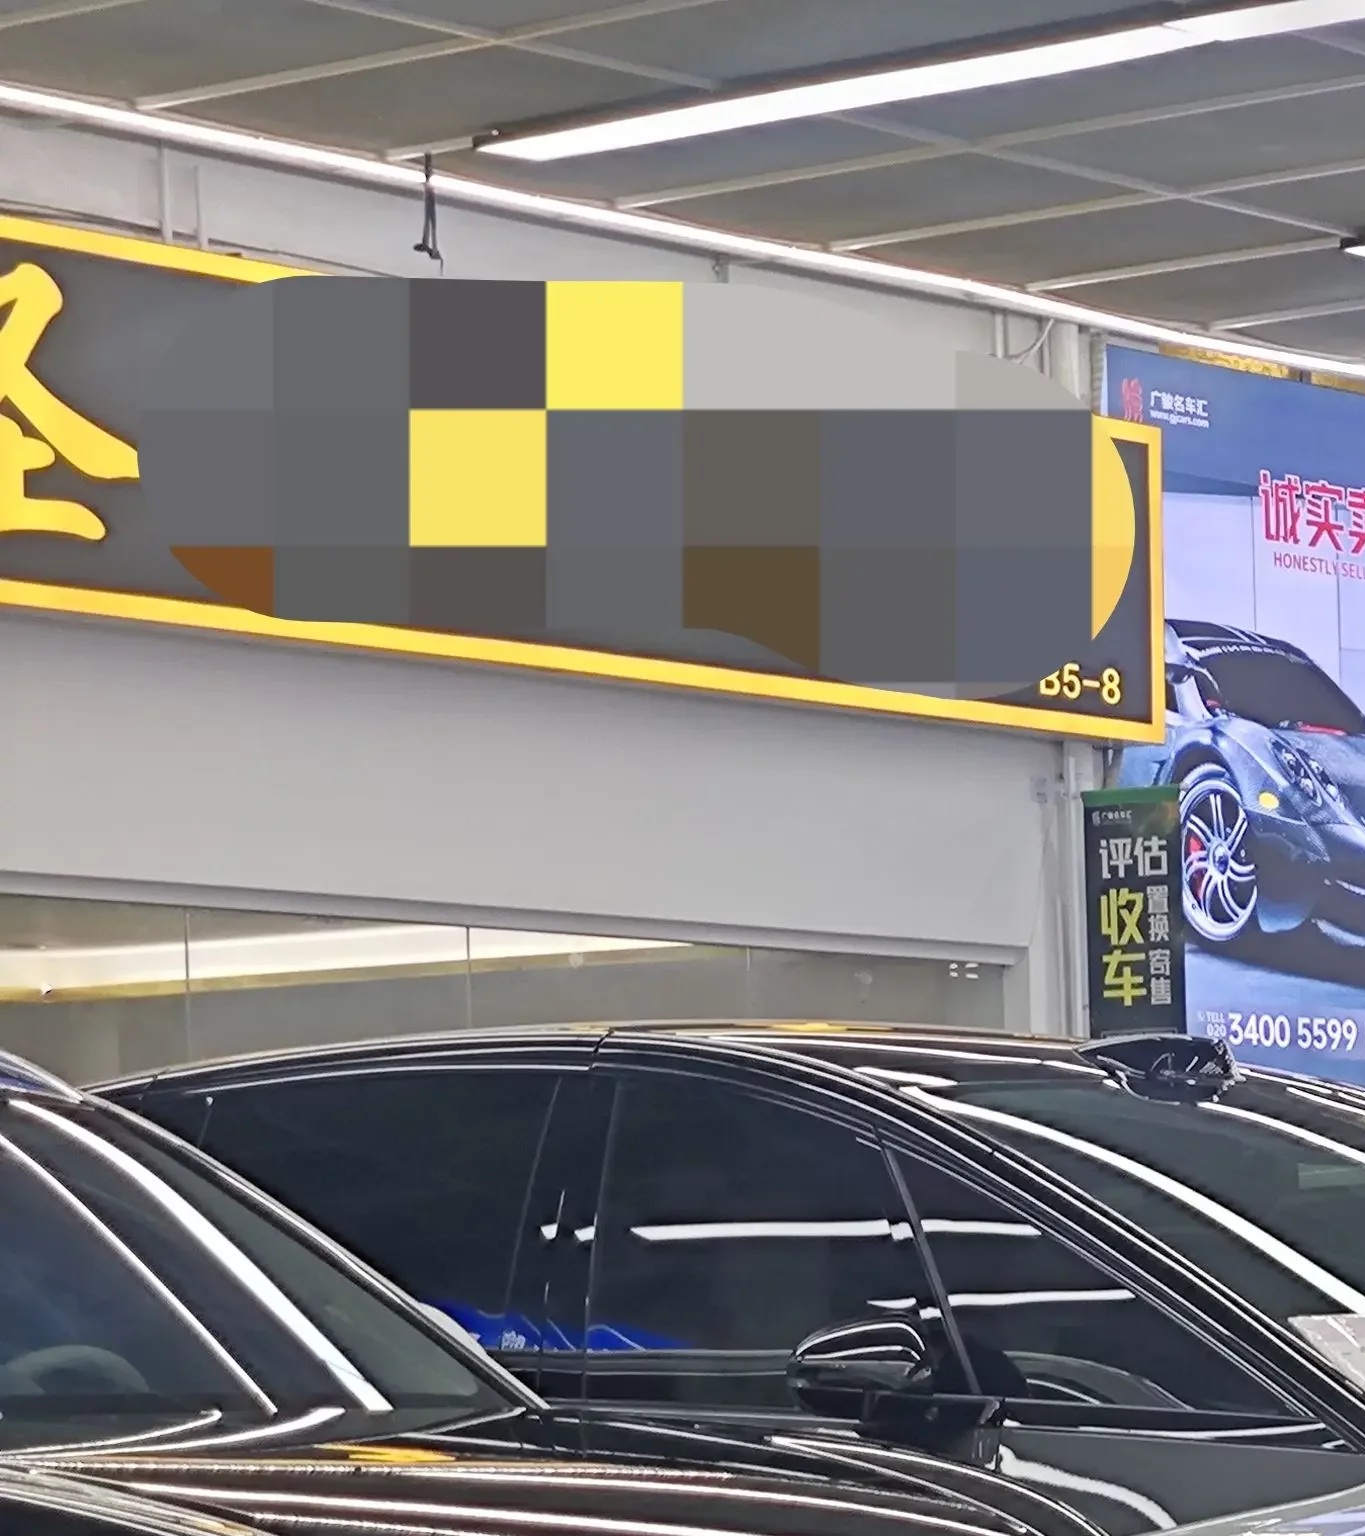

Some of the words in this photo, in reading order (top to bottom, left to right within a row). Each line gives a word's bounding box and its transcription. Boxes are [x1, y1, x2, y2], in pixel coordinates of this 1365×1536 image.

[1274, 552, 1338, 576] HONESTLY
[1099, 836, 1168, 879] 评估
[1100, 887, 1147, 1007] 收车
[1206, 1011, 1225, 1023] TELL
[1207, 1024, 1227, 1037] 020
[1228, 1012, 1291, 1048] 3400
[1297, 1017, 1358, 1051] 5599
